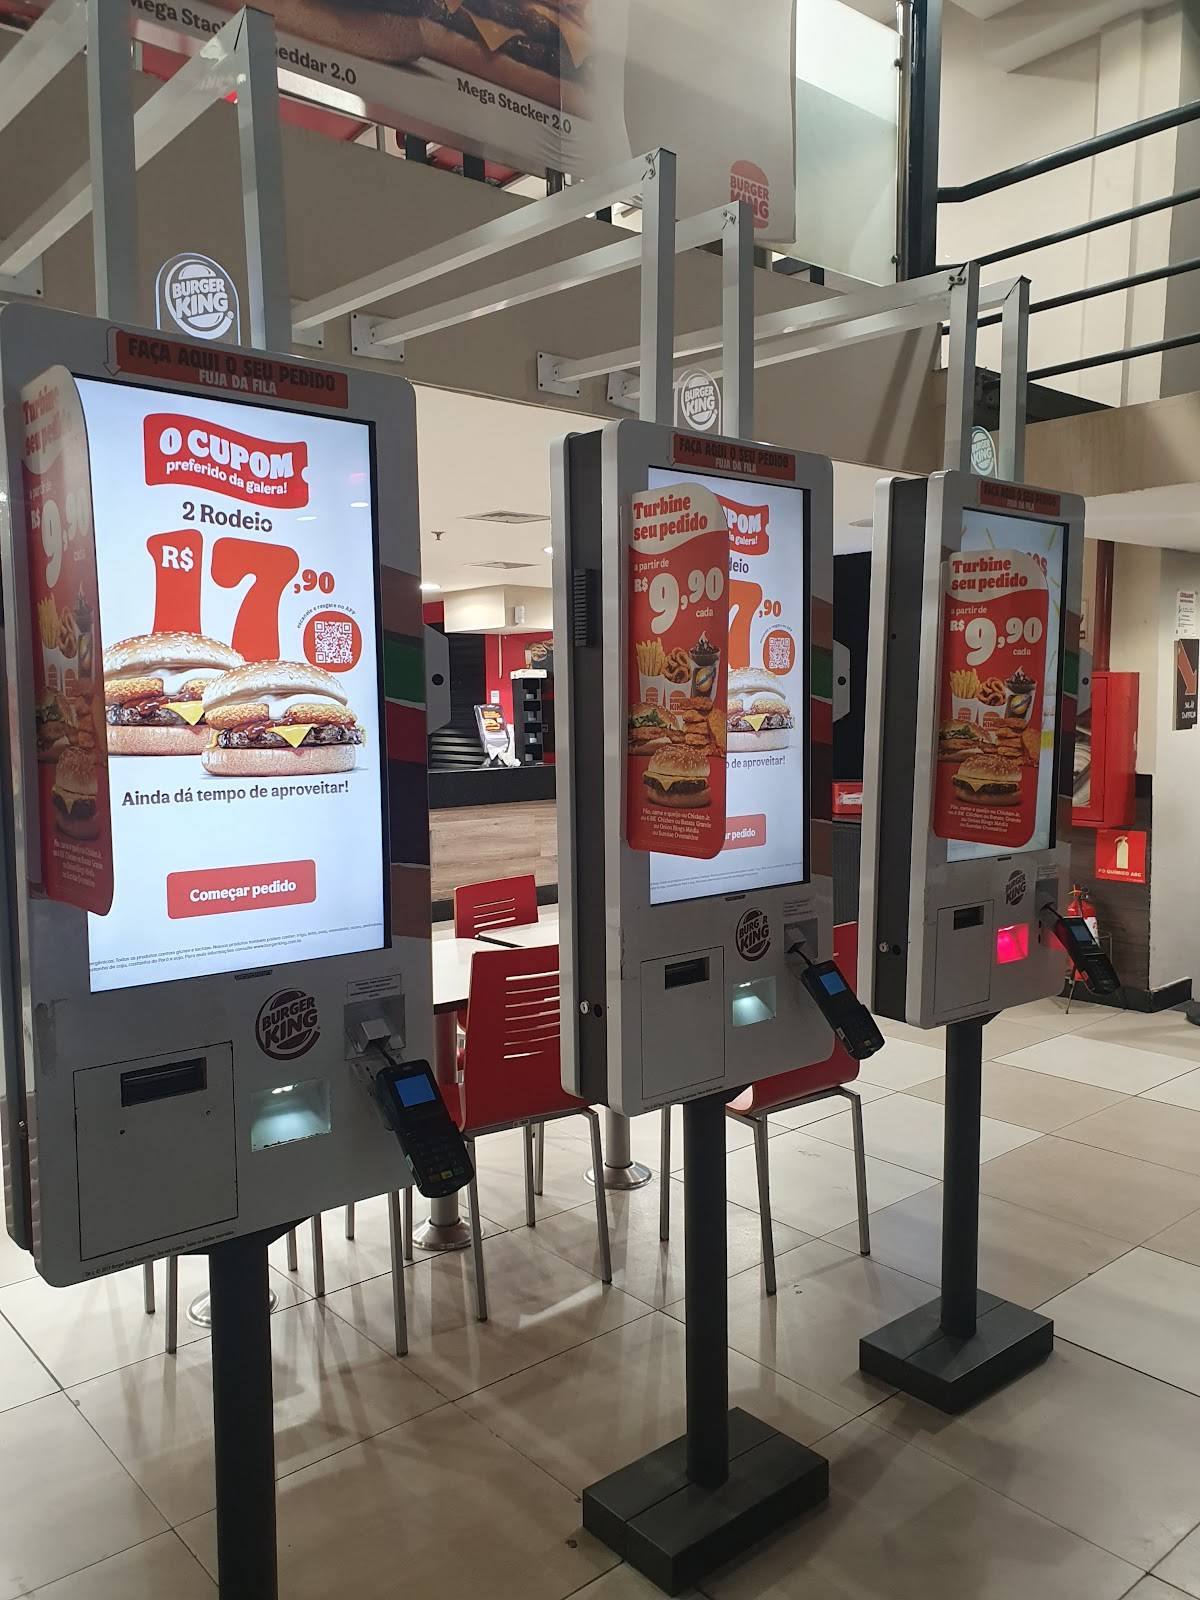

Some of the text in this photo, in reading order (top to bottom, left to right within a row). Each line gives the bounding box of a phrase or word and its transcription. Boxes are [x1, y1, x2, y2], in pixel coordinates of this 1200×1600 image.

[182, 9, 225, 36] Stac
[275, 47, 357, 87] eddar 2.0
[457, 77, 572, 134] Mega Stacker 2.0
[731, 175, 769, 201] BURGER
[172, 278, 225, 299] BURGER
[175, 292, 228, 319] KING
[128, 338, 336, 391] FAÇA AQUI O SEU PEDIDO
[199, 370, 278, 395] FUJA DA FILA
[685, 385, 714, 402] BURGER
[686, 396, 715, 417] KING
[159, 427, 294, 480] O CUPOM
[680, 437, 702, 455] FAÇA
[165, 457, 288, 496] preferido da galera!
[715, 458, 731, 469] FUJA
[181, 501, 273, 532] 2 Rodeio
[633, 494, 691, 520] Turbine
[723, 506, 762, 534] POM
[634, 511, 708, 541] seu pedido
[735, 535, 758, 546] galera!
[161, 545, 194, 572] R$
[639, 560, 659, 572] partir
[660, 558, 669, 568] de
[952, 556, 1011, 574] Turbine
[952, 572, 1028, 592] seu pedido
[634, 577, 649, 592] R$
[648, 566, 724, 634] 9,90
[695, 607, 714, 617] cada
[955, 606, 977, 616] partir
[978, 605, 988, 613] de
[949, 617, 1043, 666] R$ 9,90
[731, 758, 742, 768] de
[743, 755, 785, 770] aproveitar!
[121, 780, 349, 806] Ainda dá tempo de aproveitar!
[731, 827, 756, 841] pedido
[189, 879, 296, 903] Começar pedido
[1006, 881, 1026, 904] KING
[739, 915, 768, 939] BURGR
[741, 924, 769, 952] KING
[262, 996, 316, 1032] BURGER
[264, 1008, 318, 1050] KING
